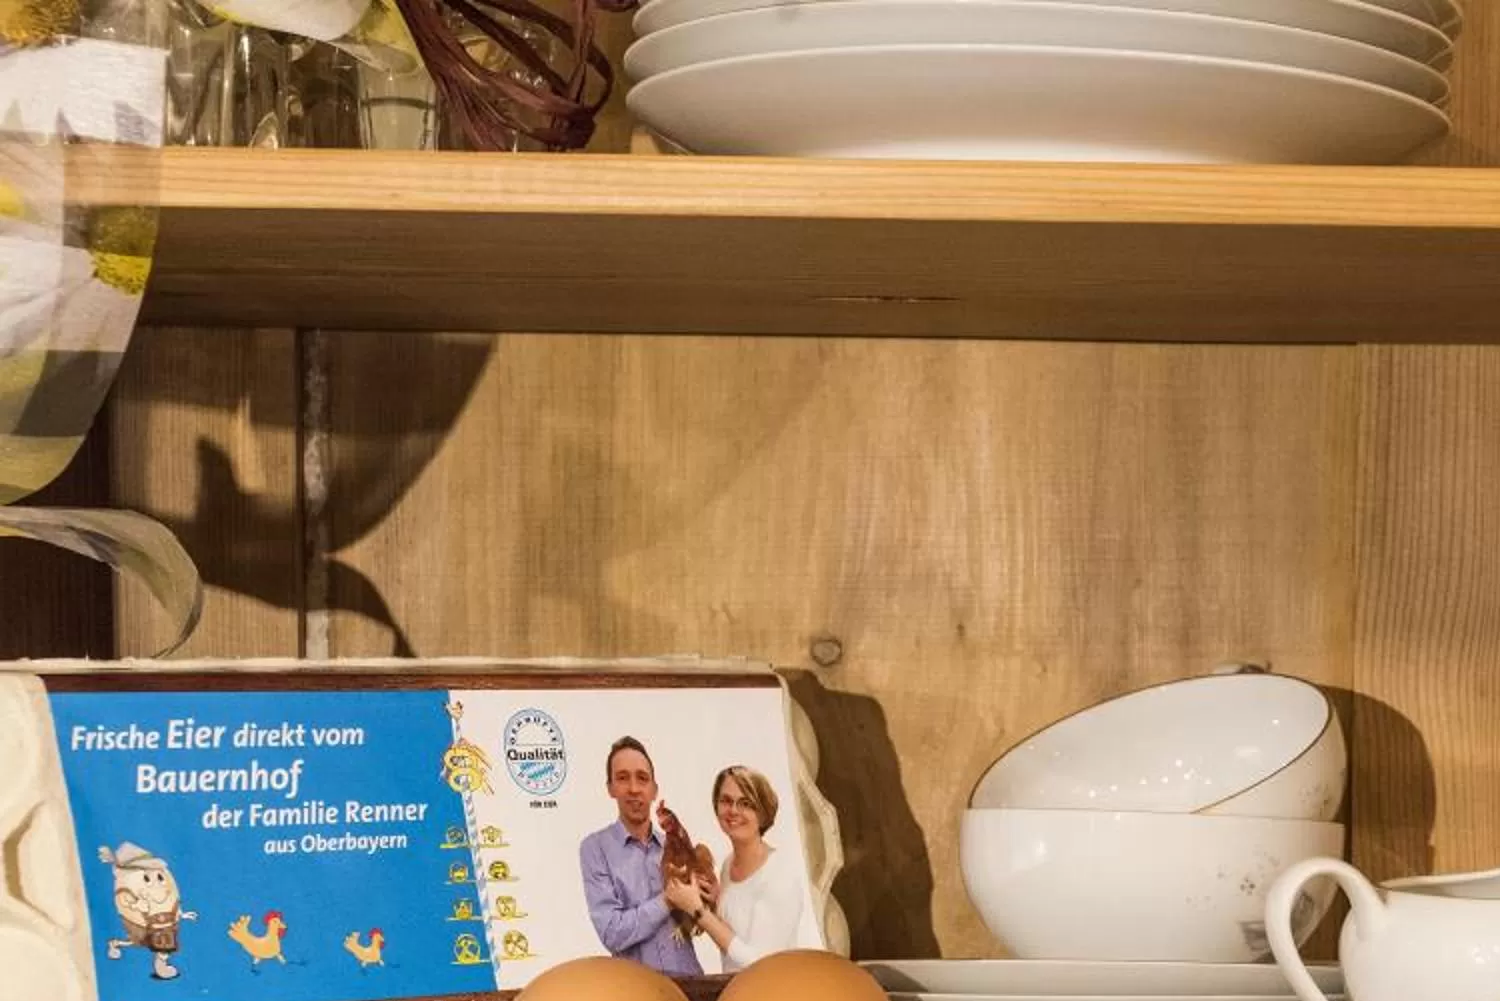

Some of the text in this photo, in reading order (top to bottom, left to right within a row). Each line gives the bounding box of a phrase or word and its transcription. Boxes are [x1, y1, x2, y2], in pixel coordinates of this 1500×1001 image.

[71, 718, 364, 751] Frische Eier direkt vom
[507, 748, 564, 761] Qualität
[136, 760, 304, 797] Bauernhof
[202, 801, 429, 830] der Familie Renner
[264, 832, 408, 856] aus Oberbayern
